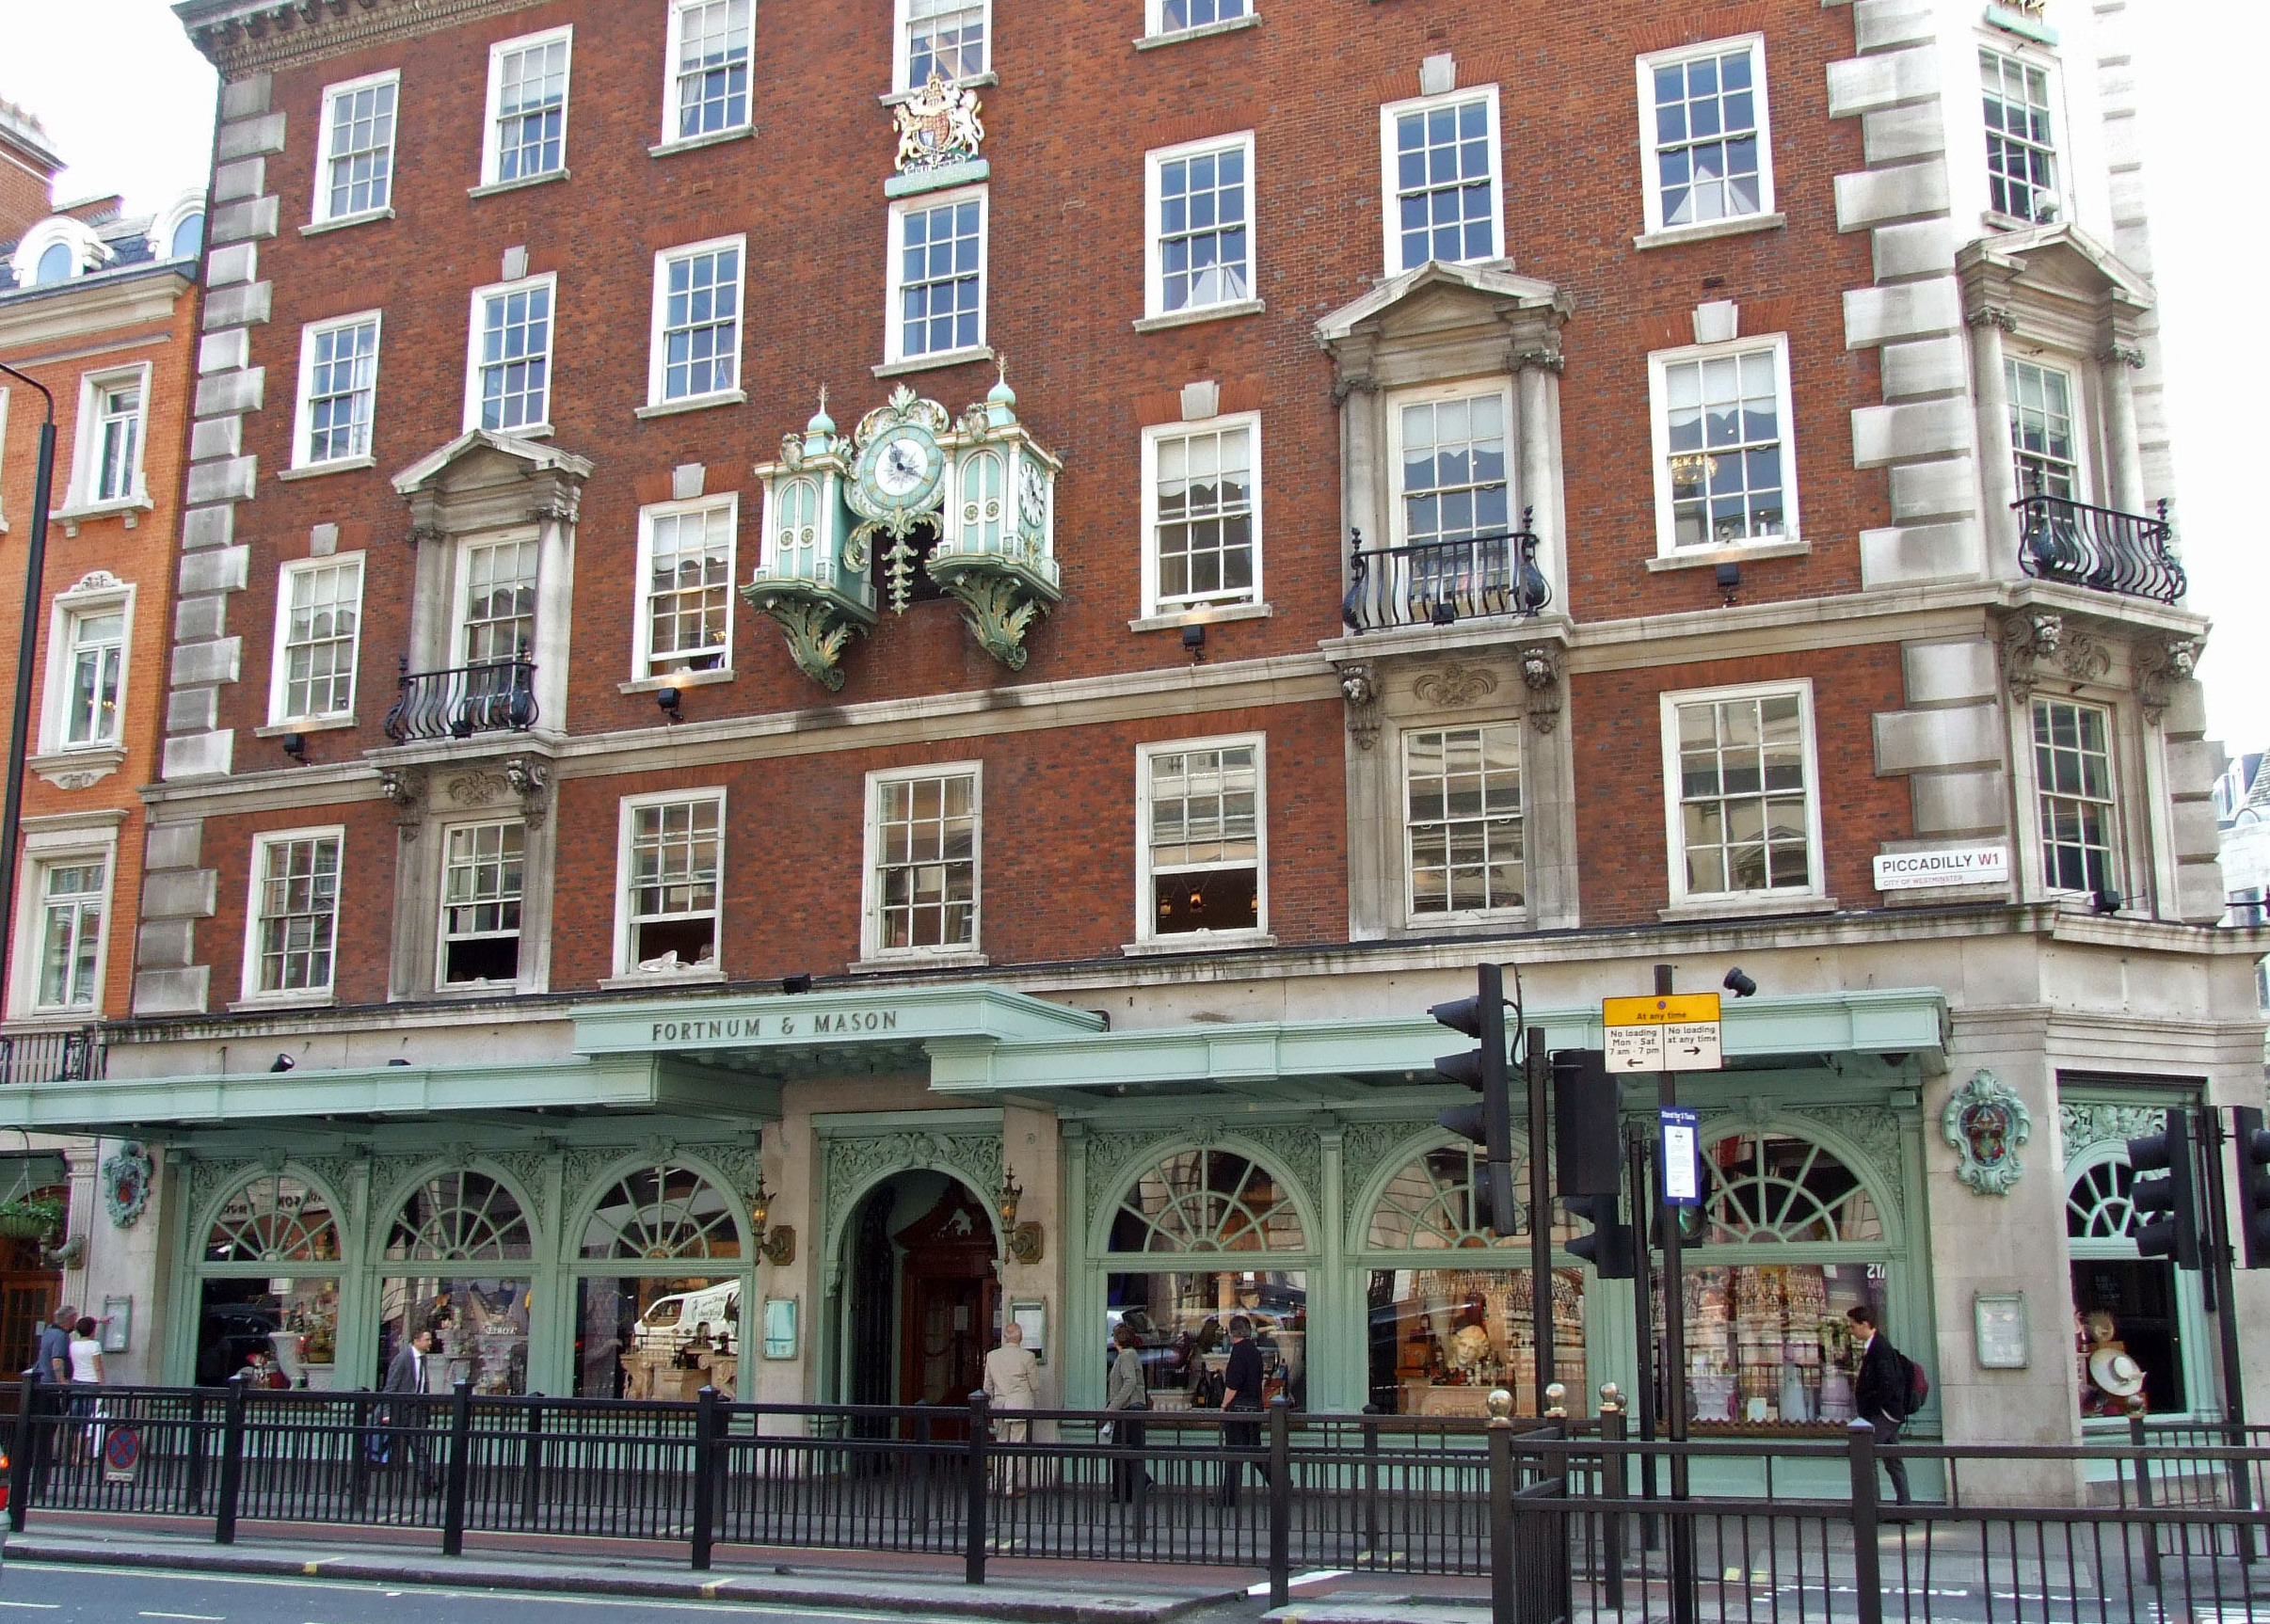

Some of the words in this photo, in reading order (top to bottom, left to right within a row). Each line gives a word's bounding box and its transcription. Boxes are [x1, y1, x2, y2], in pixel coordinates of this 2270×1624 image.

[1883, 854, 1973, 873] PICCADILLY
[1978, 853, 1999, 866] W1
[1883, 879, 1900, 887] CITY
[1912, 875, 1963, 884] WESTMINSTER
[651, 1018, 761, 1042] FORTNUM
[781, 1016, 795, 1035] &
[815, 1011, 899, 1033] MASON
[1684, 1026, 1716, 1035] loading
[1625, 1029, 1657, 1038] loading
